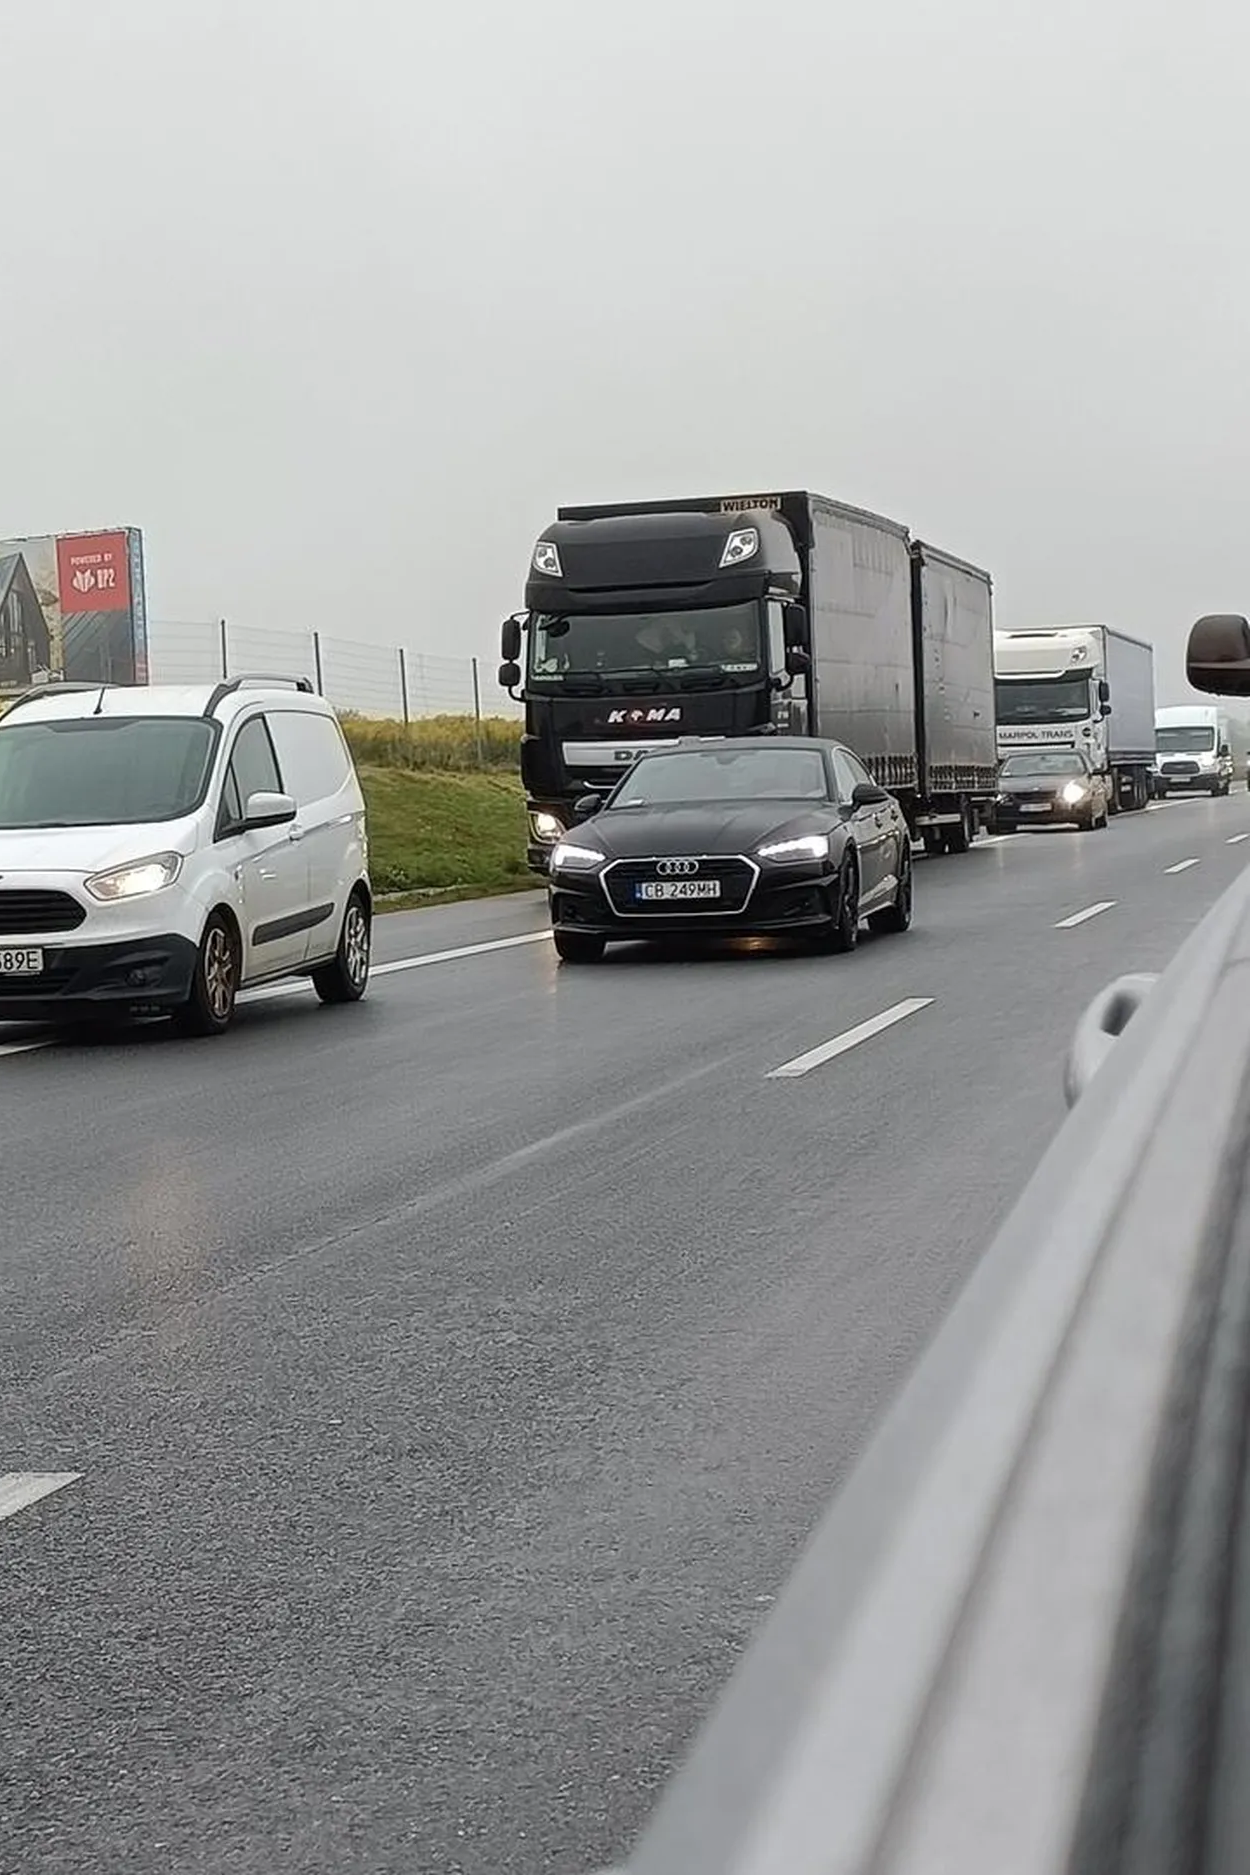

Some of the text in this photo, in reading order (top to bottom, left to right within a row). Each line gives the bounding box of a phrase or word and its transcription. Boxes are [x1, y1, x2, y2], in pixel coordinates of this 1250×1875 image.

[723, 498, 778, 511] WIELTON
[1042, 730, 1073, 739] TRANS
[645, 883, 664, 898] CB
